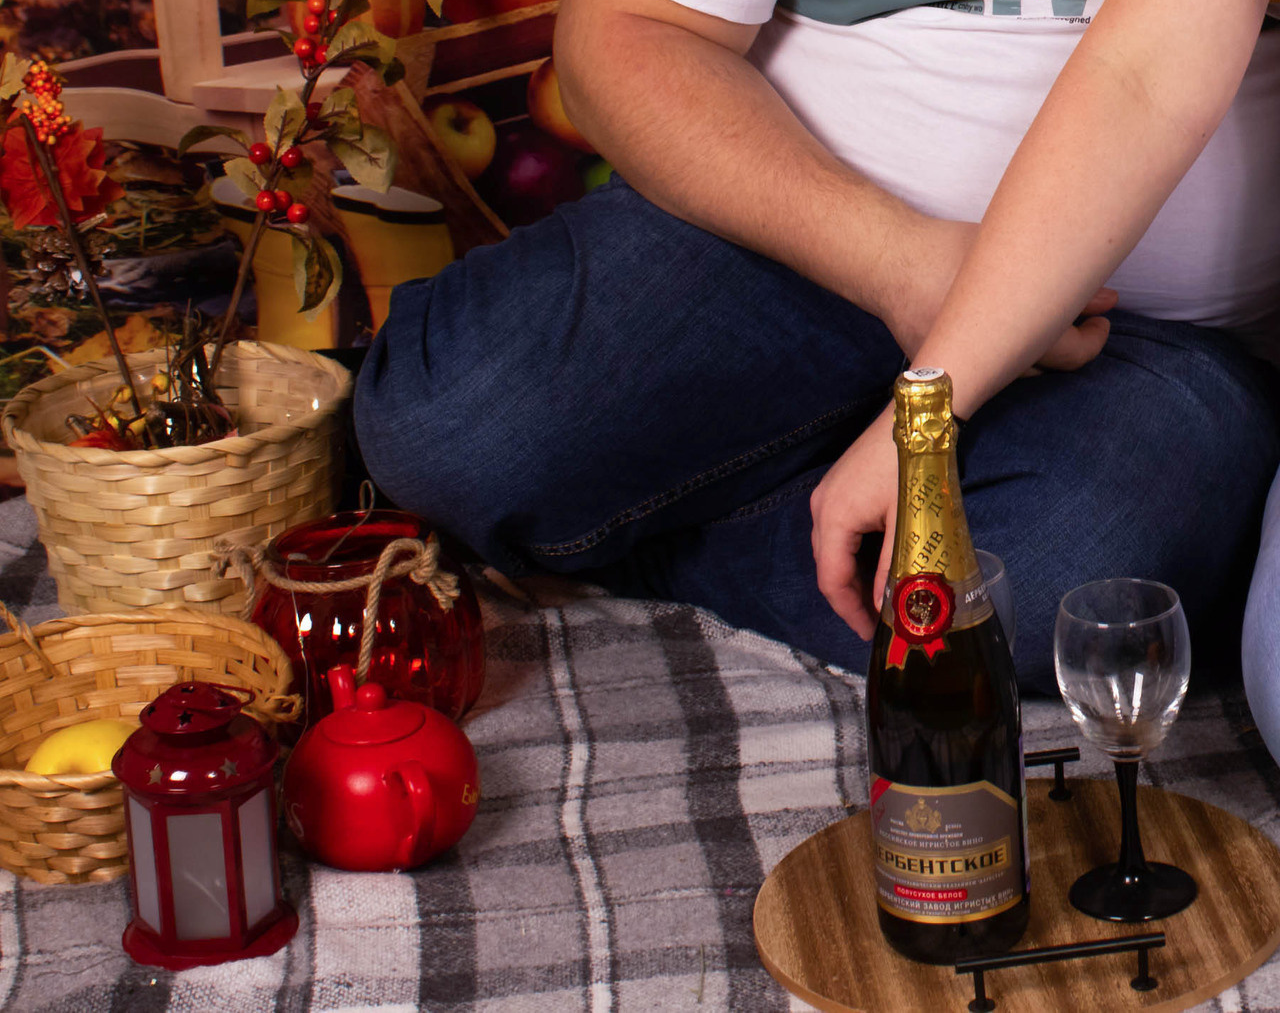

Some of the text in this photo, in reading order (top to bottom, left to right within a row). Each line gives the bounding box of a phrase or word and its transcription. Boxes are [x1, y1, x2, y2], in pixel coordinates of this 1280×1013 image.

[911, 530, 944, 574] ДЗИВ
[877, 846, 1005, 874] ЕРБЕНТСКОЕ
[938, 891, 963, 899] БЕЛОЕ
[923, 902, 951, 911] ЗАВОД
